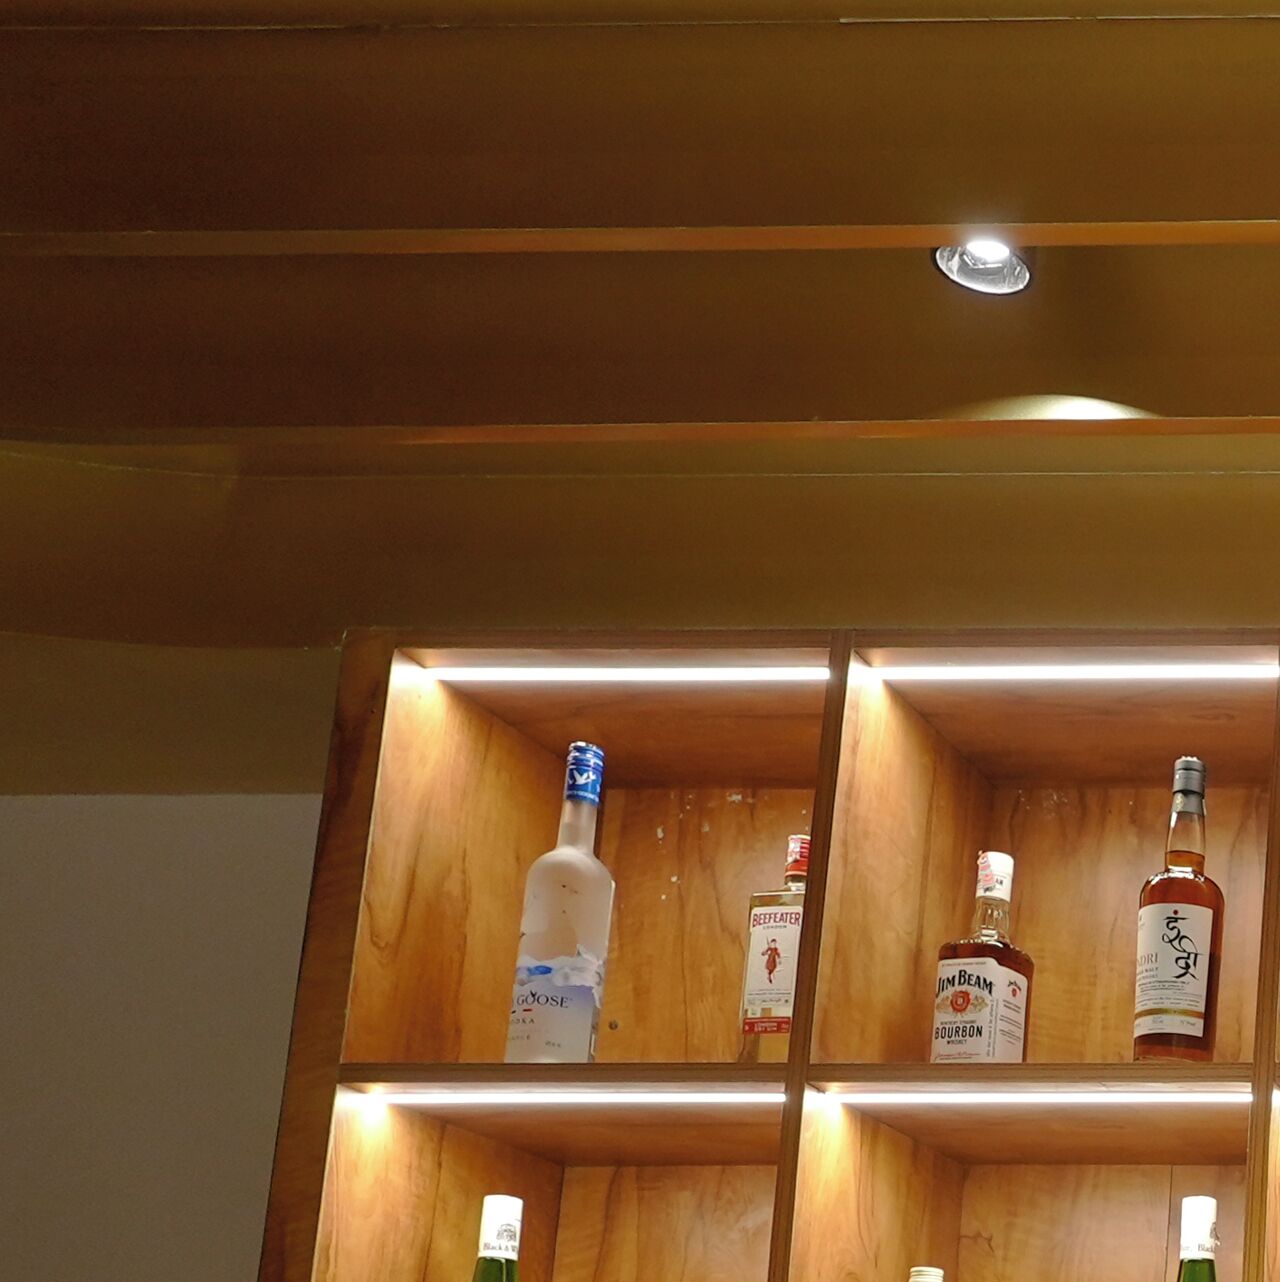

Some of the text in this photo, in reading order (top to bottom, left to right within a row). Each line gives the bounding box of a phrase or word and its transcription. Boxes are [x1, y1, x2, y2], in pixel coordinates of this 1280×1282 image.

[752, 911, 801, 928] BEEFEATER
[936, 968, 994, 999] JIM BEAM
[517, 989, 568, 1009] GOOSE
[934, 1025, 984, 1040] BOURBON
